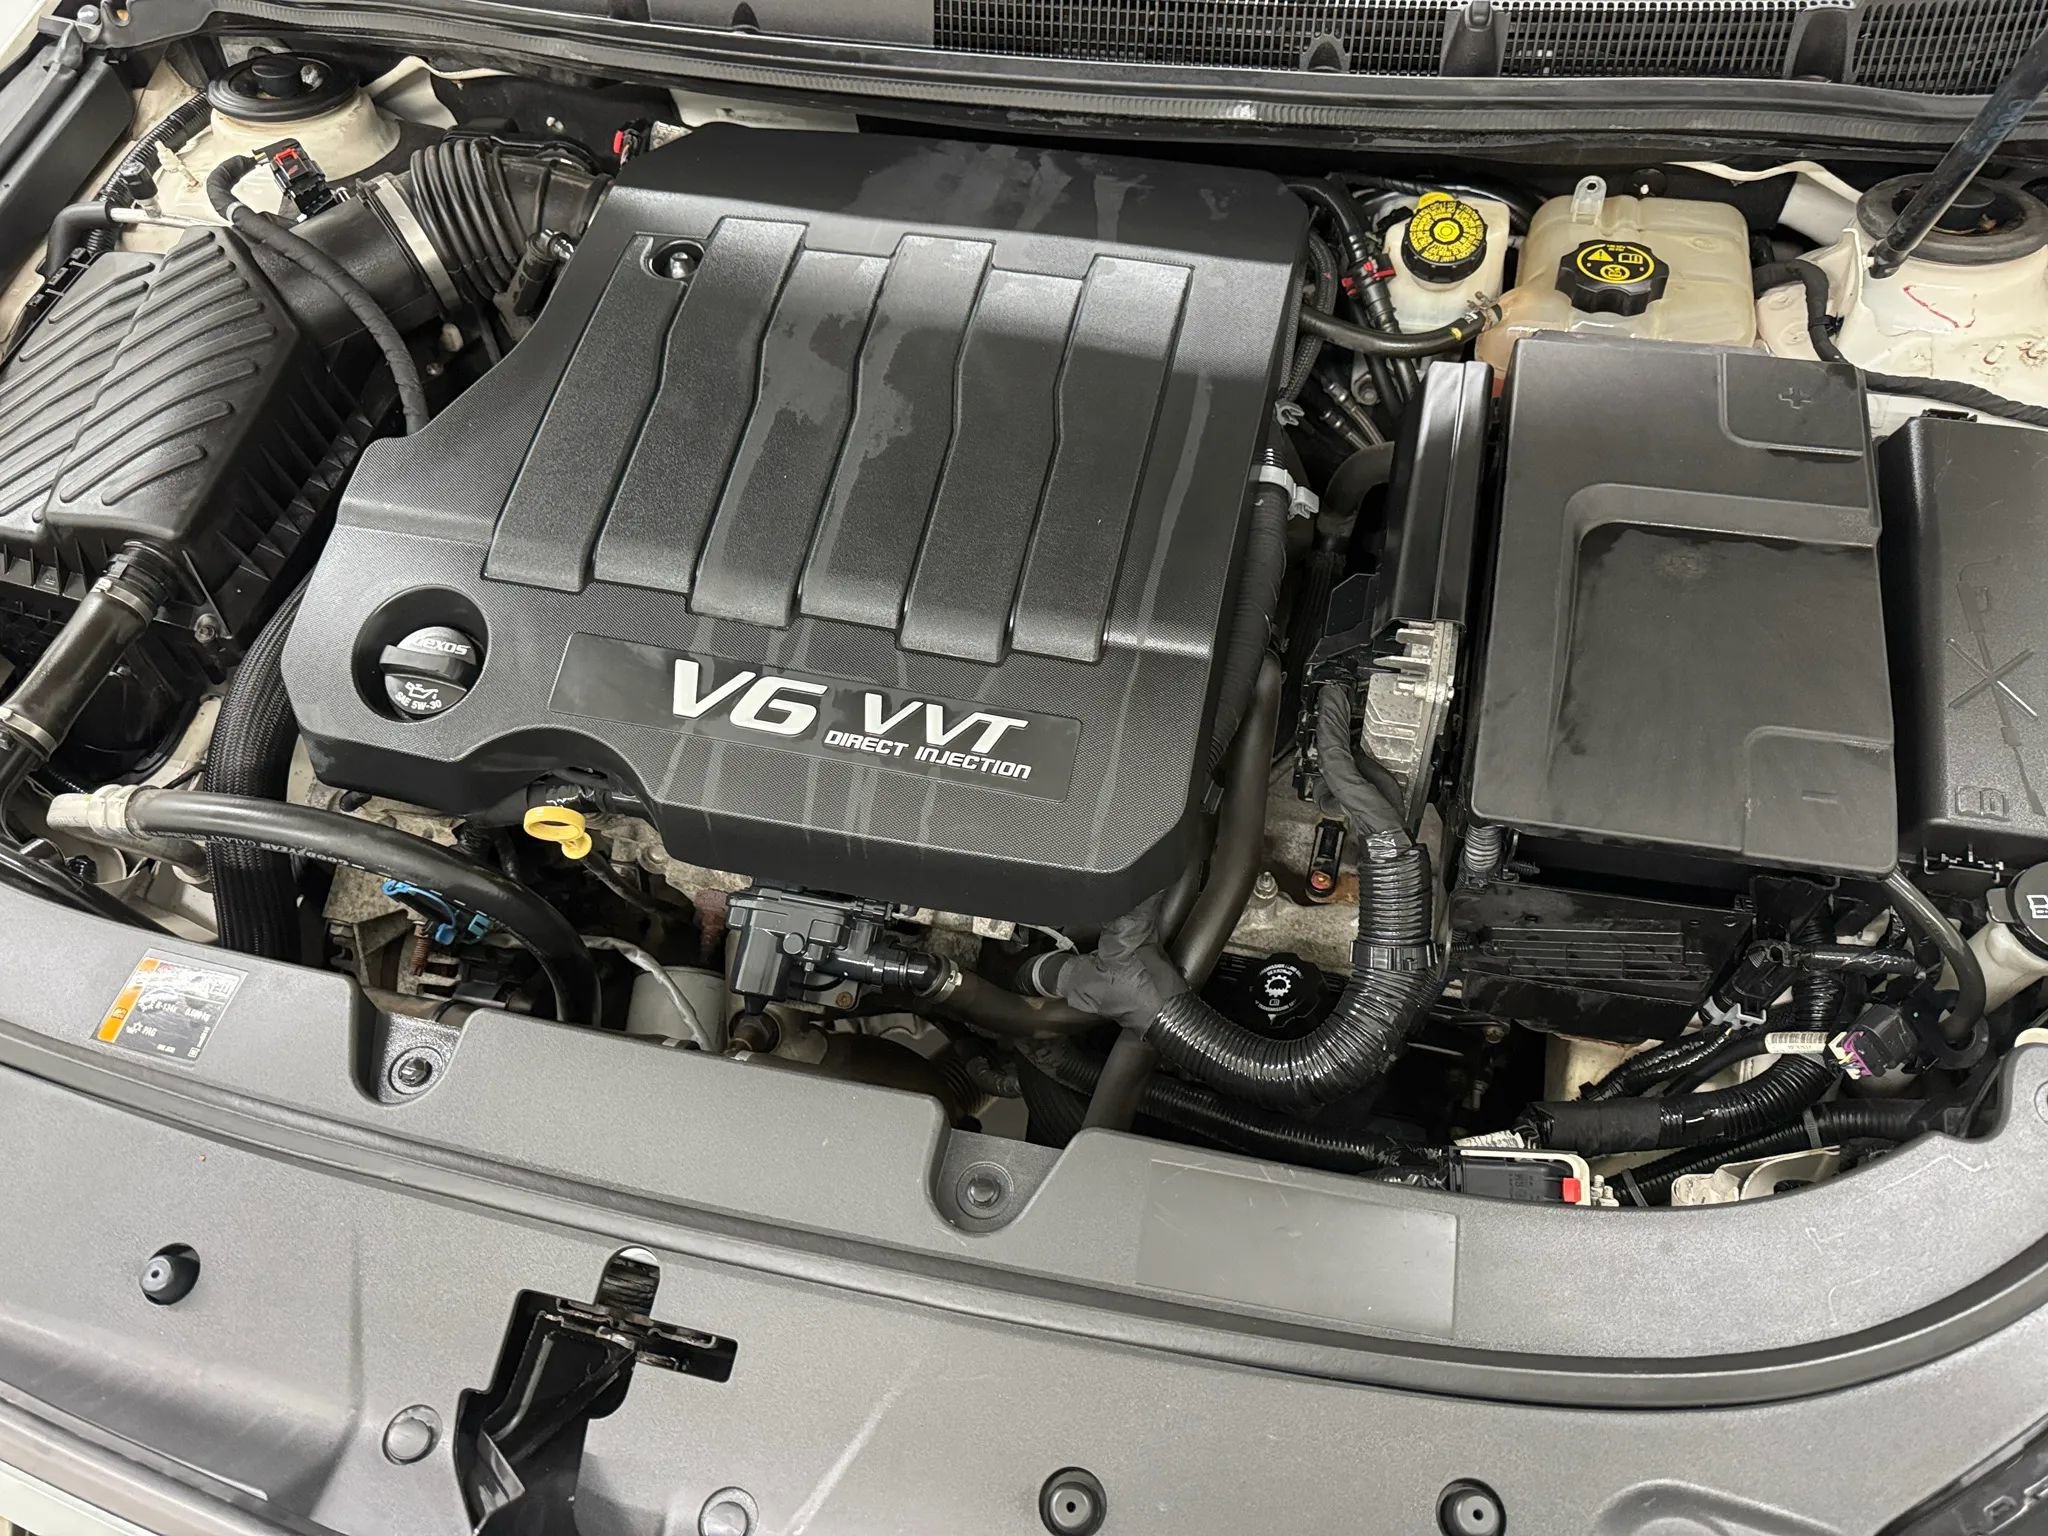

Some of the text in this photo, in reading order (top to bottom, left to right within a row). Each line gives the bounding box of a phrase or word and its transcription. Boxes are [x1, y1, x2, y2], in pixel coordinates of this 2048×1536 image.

[395, 691, 442, 711] SAE 5W-30
[672, 657, 1031, 754] V6 VVT
[823, 729, 1032, 781] DIRECT INJECTION
[209, 834, 257, 848] GALAXY
[142, 1025, 158, 1037] PAG
